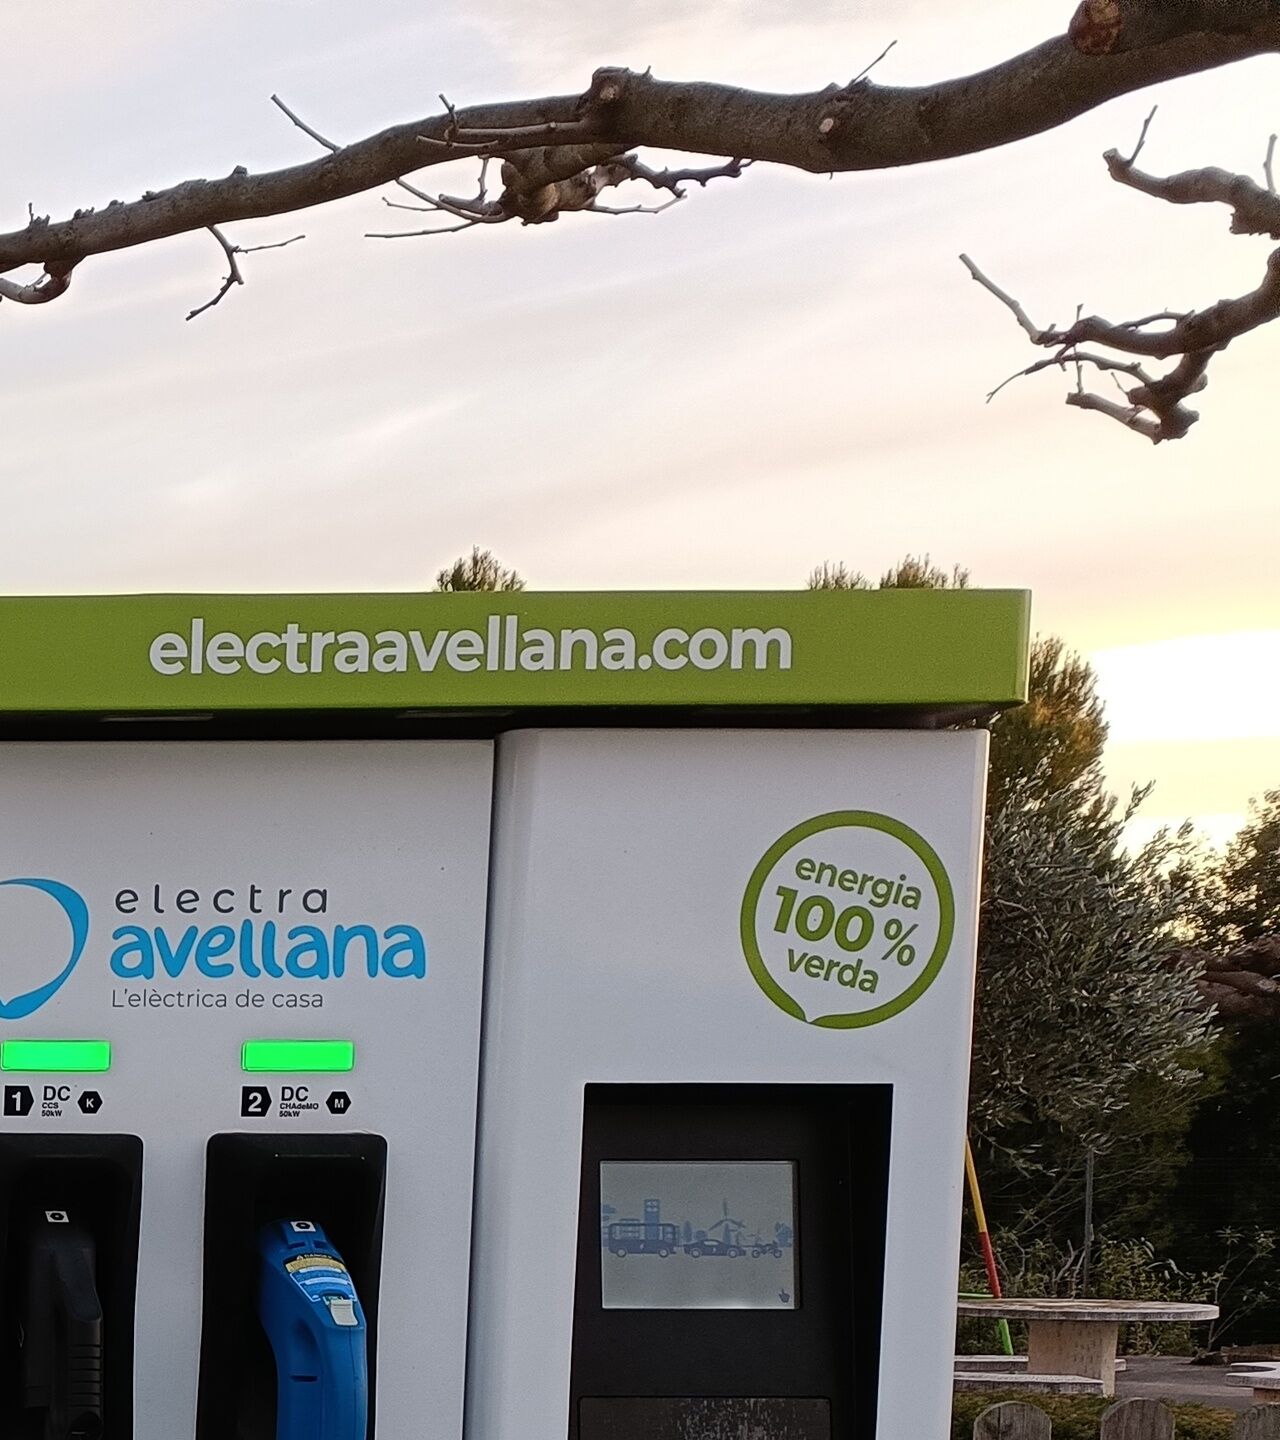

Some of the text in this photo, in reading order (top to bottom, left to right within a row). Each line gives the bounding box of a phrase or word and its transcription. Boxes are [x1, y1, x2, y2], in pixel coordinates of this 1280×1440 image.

[148, 614, 792, 676] electraavellana.com
[795, 857, 922, 910] energia
[114, 883, 329, 914] electra
[773, 885, 919, 967] 100 %
[109, 918, 426, 980] avellana
[787, 947, 879, 994] verda
[112, 988, 324, 1009] L'elèctrica de casa
[11, 1091, 22, 1112] 1
[43, 1085, 71, 1102] DC
[85, 1098, 95, 1108] K
[247, 1092, 262, 1112] 2
[281, 1086, 309, 1102] DC
[334, 1098, 345, 1109] M
[279, 1102, 319, 1110] CHAdeMO
